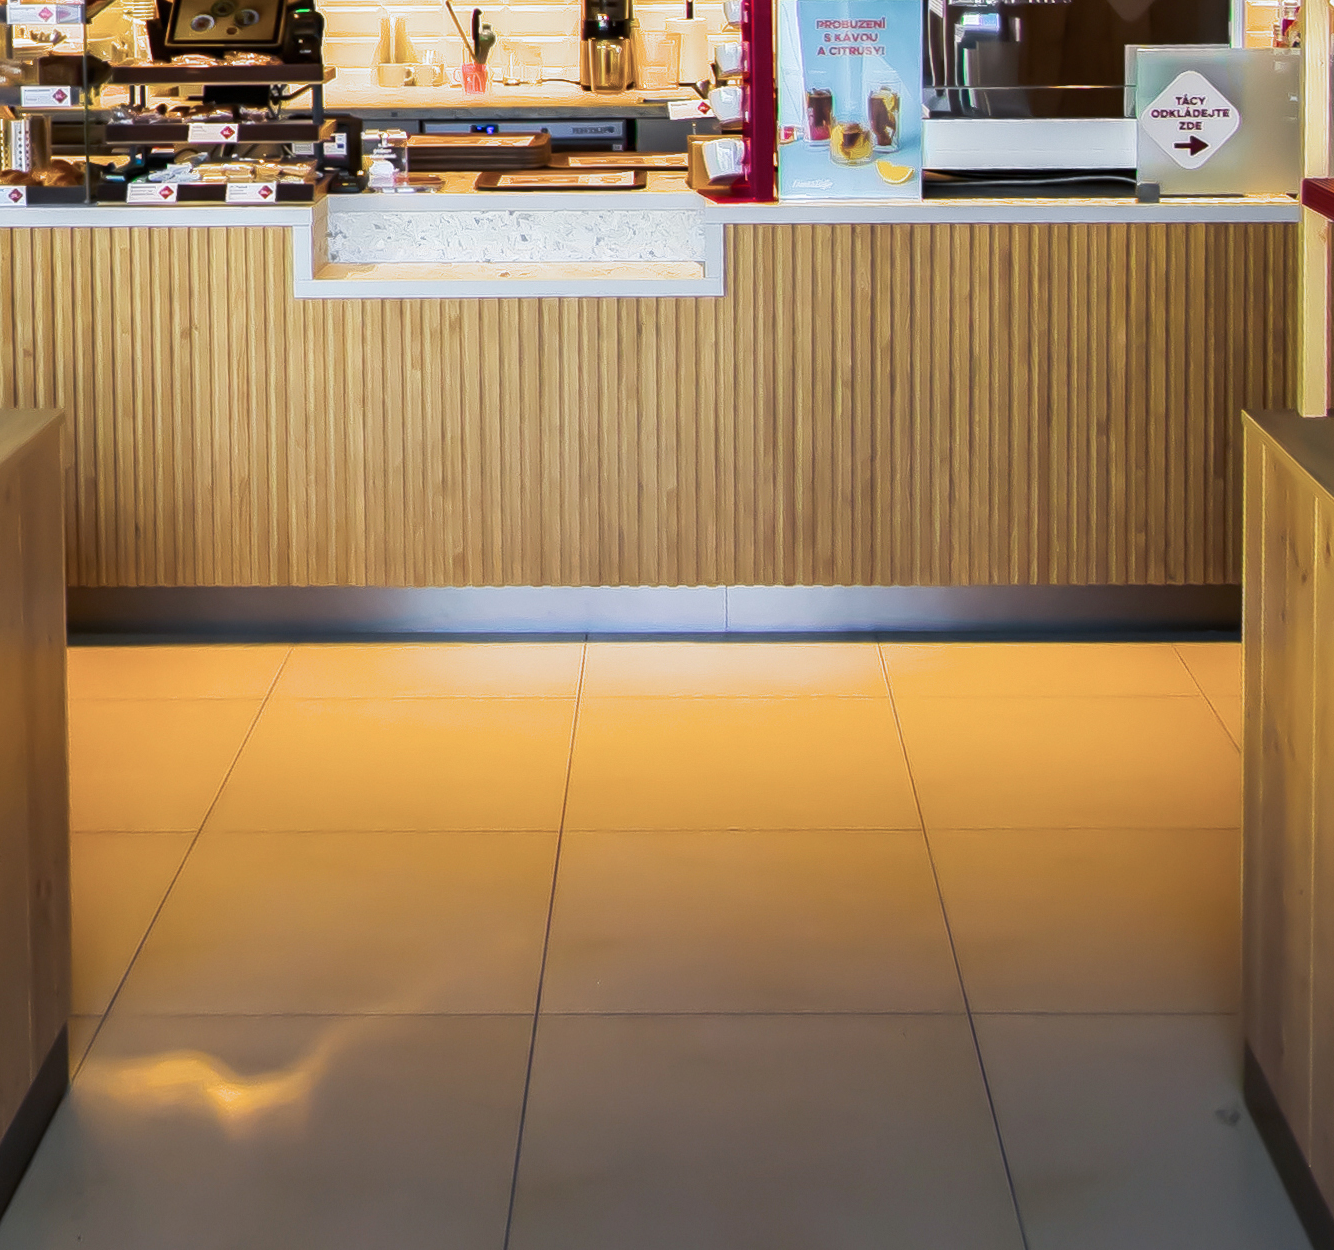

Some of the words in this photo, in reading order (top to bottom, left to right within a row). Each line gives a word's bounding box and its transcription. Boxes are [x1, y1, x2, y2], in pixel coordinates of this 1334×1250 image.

[816, 17, 886, 30] PROBUZENÍ
[824, 33, 831, 42] S
[834, 31, 878, 42] KÁVOU
[817, 47, 826, 56] A
[1175, 93, 1206, 106] TÁCY
[1151, 108, 1230, 119] ODKLÁDEJTE
[1179, 121, 1203, 131] ZDE
